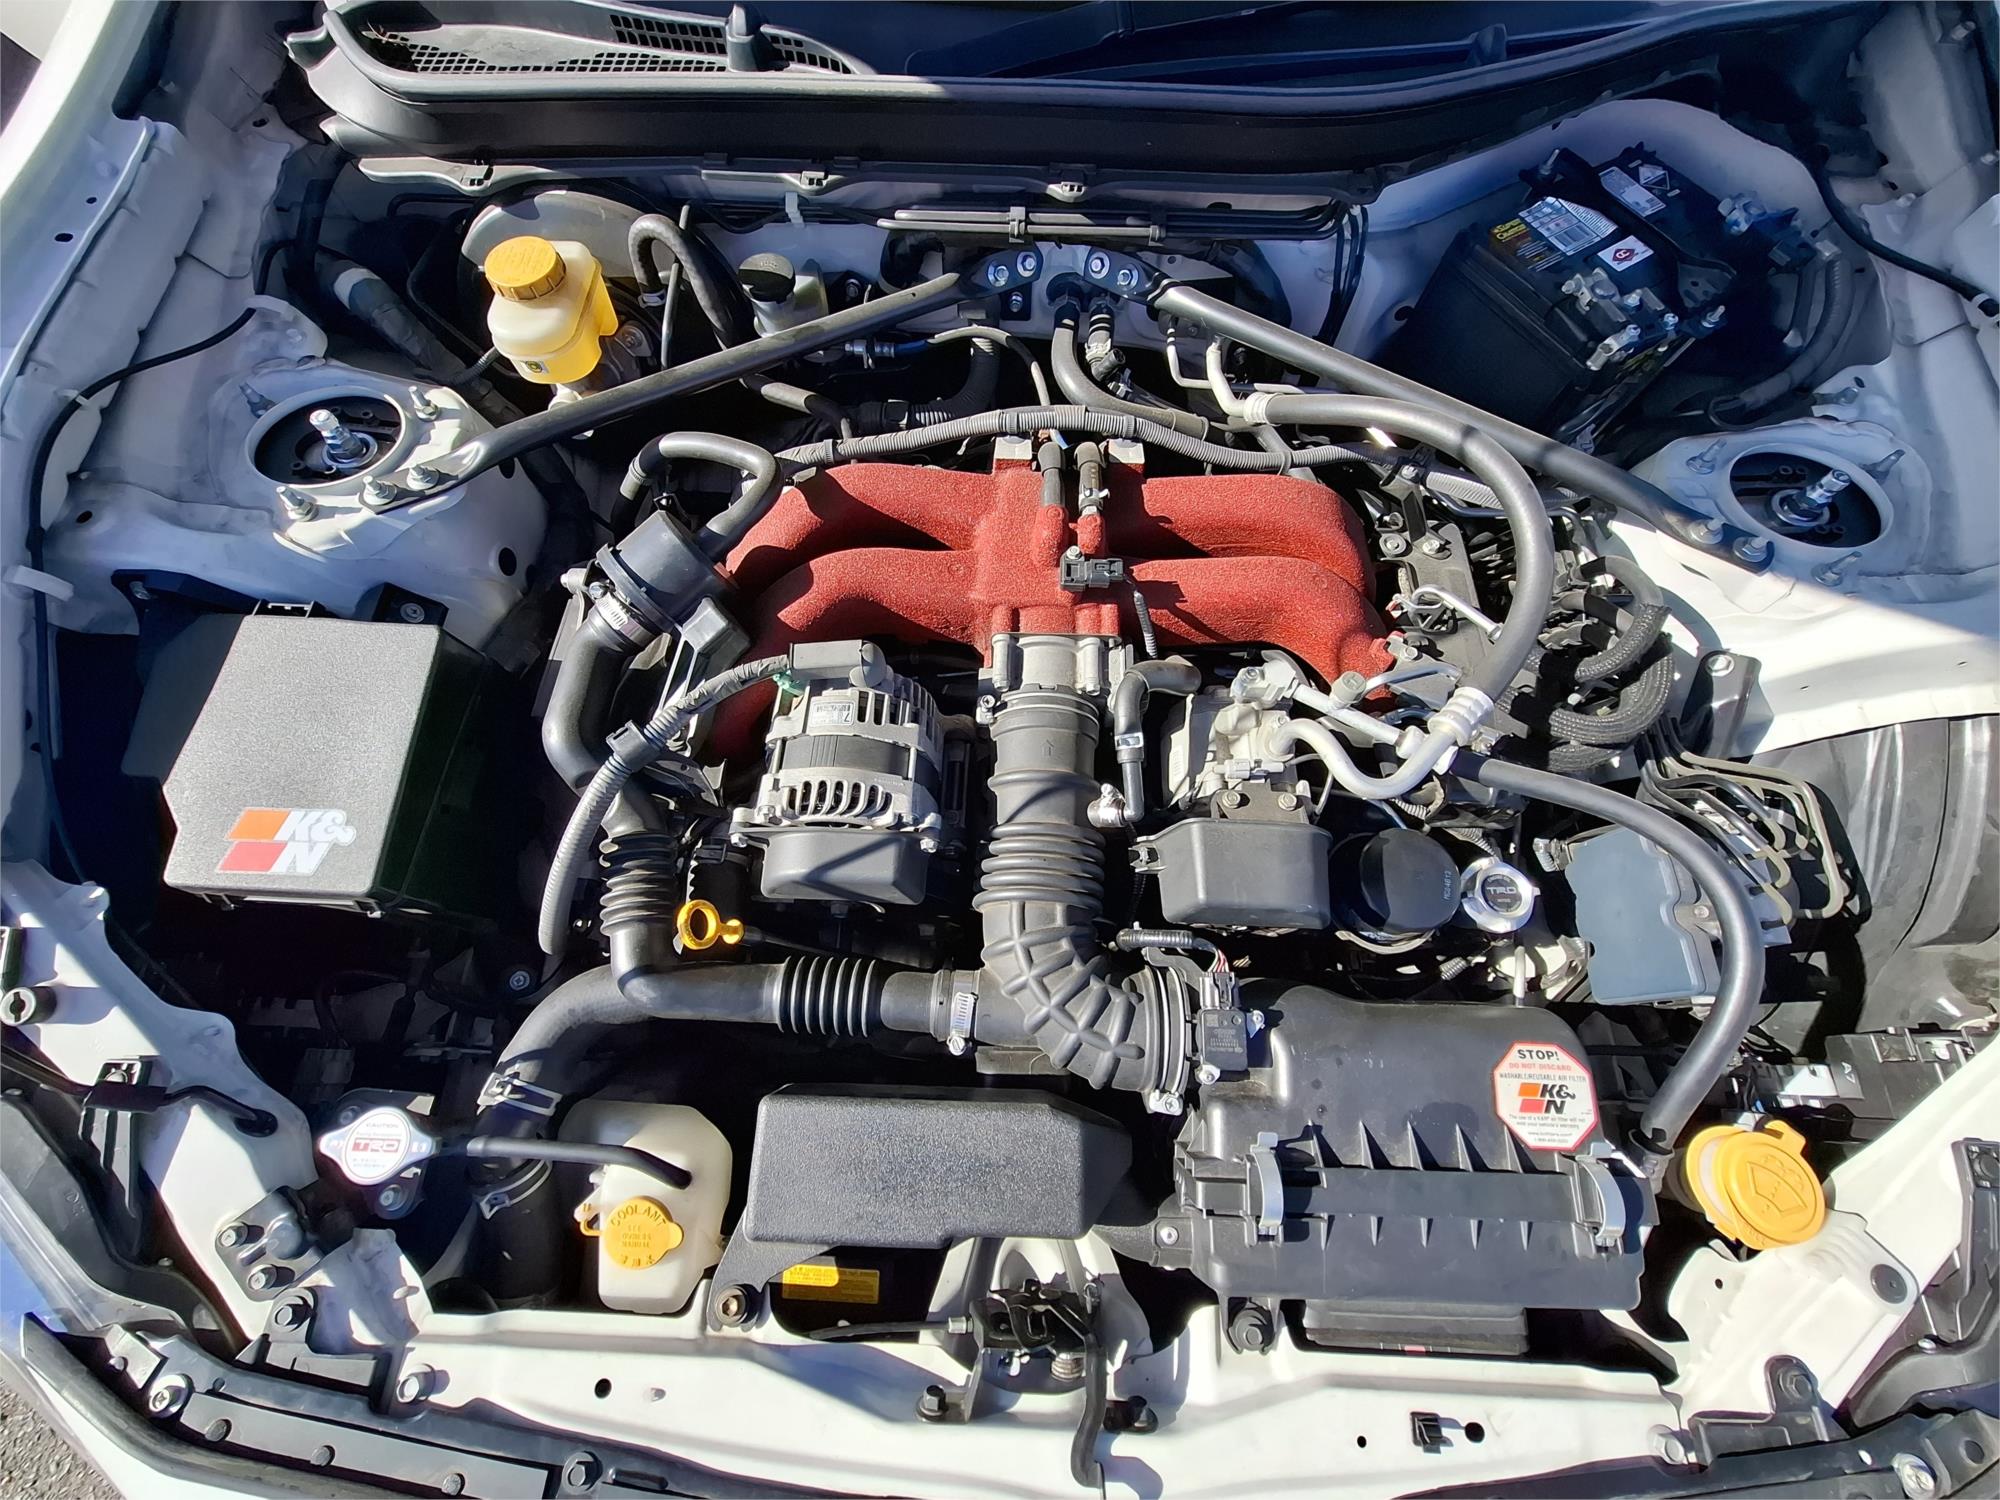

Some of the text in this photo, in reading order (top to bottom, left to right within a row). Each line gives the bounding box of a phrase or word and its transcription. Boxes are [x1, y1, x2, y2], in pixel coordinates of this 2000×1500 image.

[1487, 886, 1516, 894] TRD
[1517, 1049, 1560, 1060] STOP!
[1539, 1063, 1571, 1071] DISCARD
[1841, 1061, 1856, 1084] A7
[352, 1138, 400, 1153] TRD
[610, 1205, 666, 1226] COOLANT
